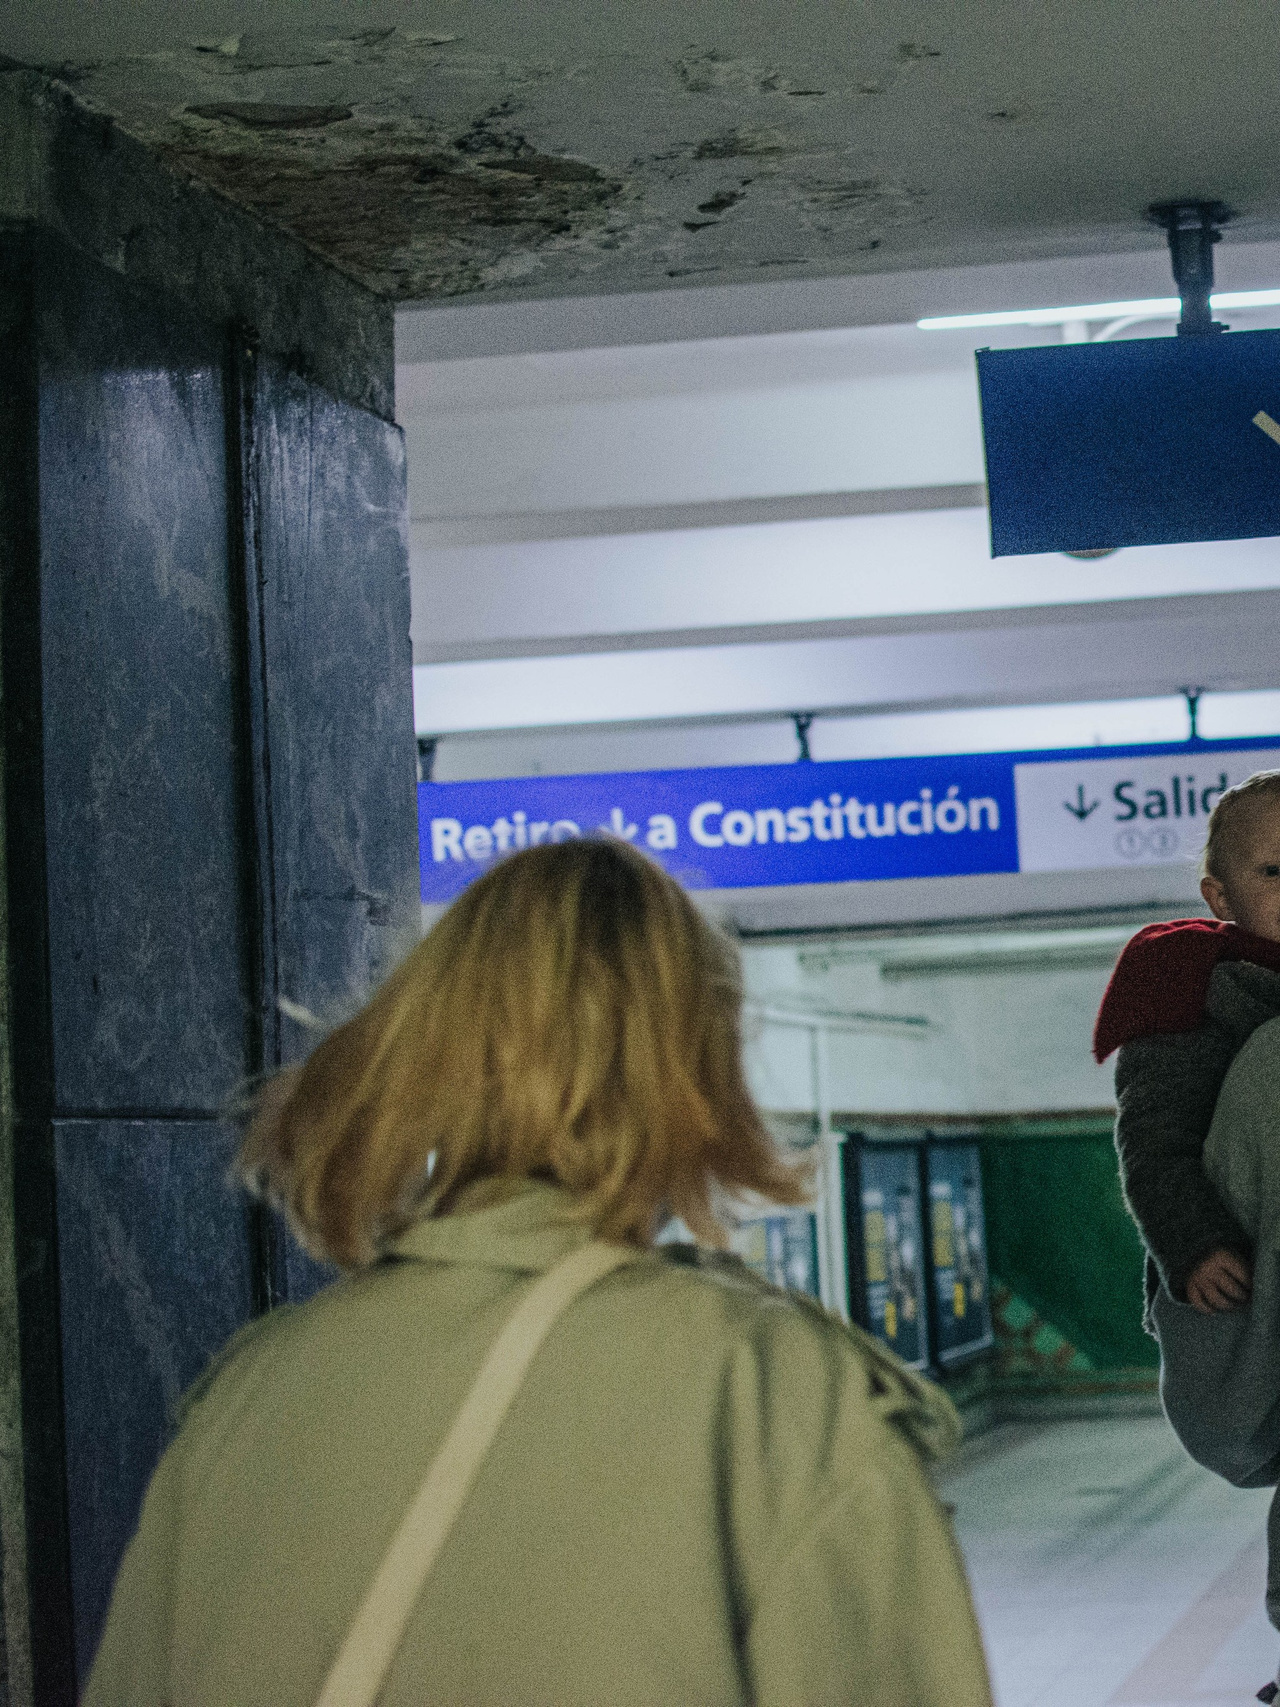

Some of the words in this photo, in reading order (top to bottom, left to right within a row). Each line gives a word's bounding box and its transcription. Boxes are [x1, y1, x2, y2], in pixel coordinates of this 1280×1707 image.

[647, 814, 678, 849] a
[689, 786, 1000, 848] Constitución
[1113, 773, 1228, 821] Salid
